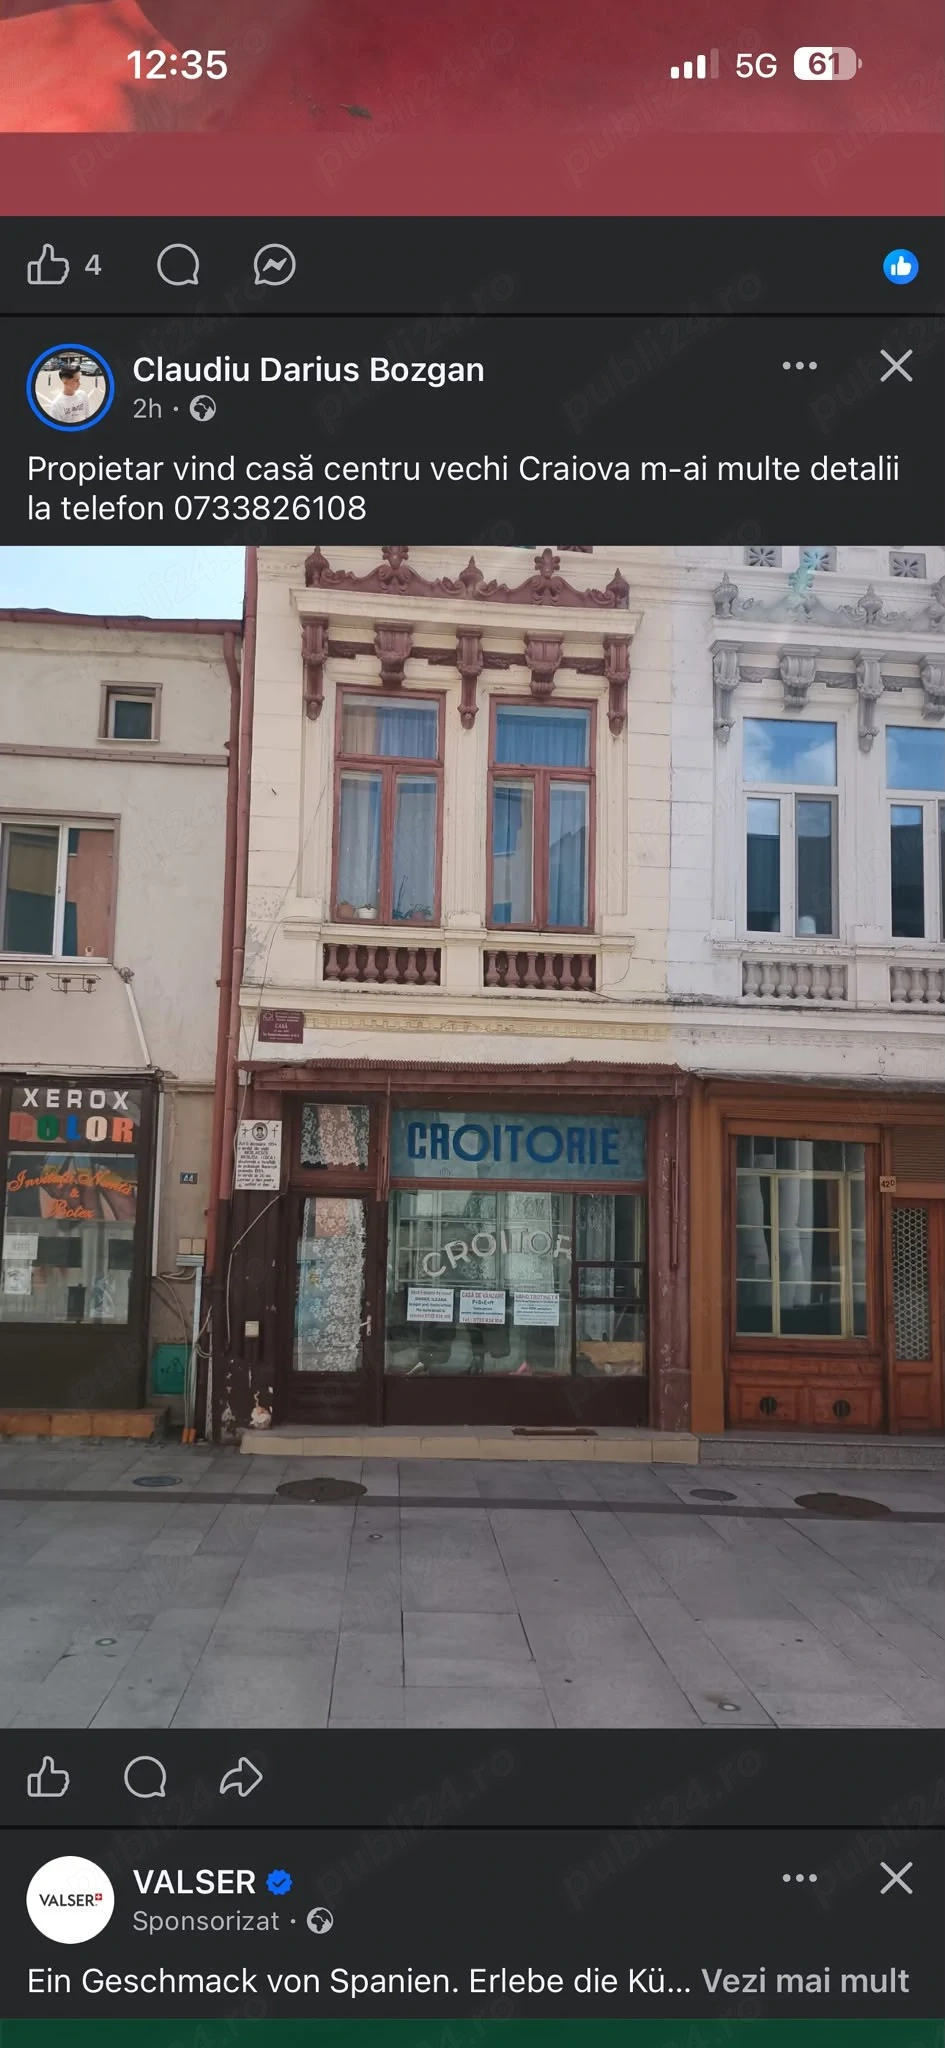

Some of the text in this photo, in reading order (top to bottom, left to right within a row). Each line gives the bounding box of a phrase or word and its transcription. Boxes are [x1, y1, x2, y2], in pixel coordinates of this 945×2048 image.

[126, 50, 228, 80] 12:35
[735, 52, 778, 79] 5G
[808, 52, 840, 75] 61
[84, 253, 102, 276] 4
[133, 355, 484, 388] Claudiu Darius Bozgan
[133, 398, 162, 419] 2h
[28, 454, 899, 487] Propietar vind casă centru vechi Craiova m-ai multe detalii
[28, 495, 367, 521] la telefon 0733826108
[22, 1088, 129, 1110] XEROX
[9, 1113, 134, 1143] COLOR
[407, 1122, 620, 1165] CROITORIE
[132, 1868, 256, 1895] VALSER
[39, 1894, 95, 1908] VALSER
[132, 1910, 280, 1936] Sponsorizat
[28, 1967, 910, 1999] Ein Geschmack von Spanien. Erlebe die Kü... Vezi mai mult
